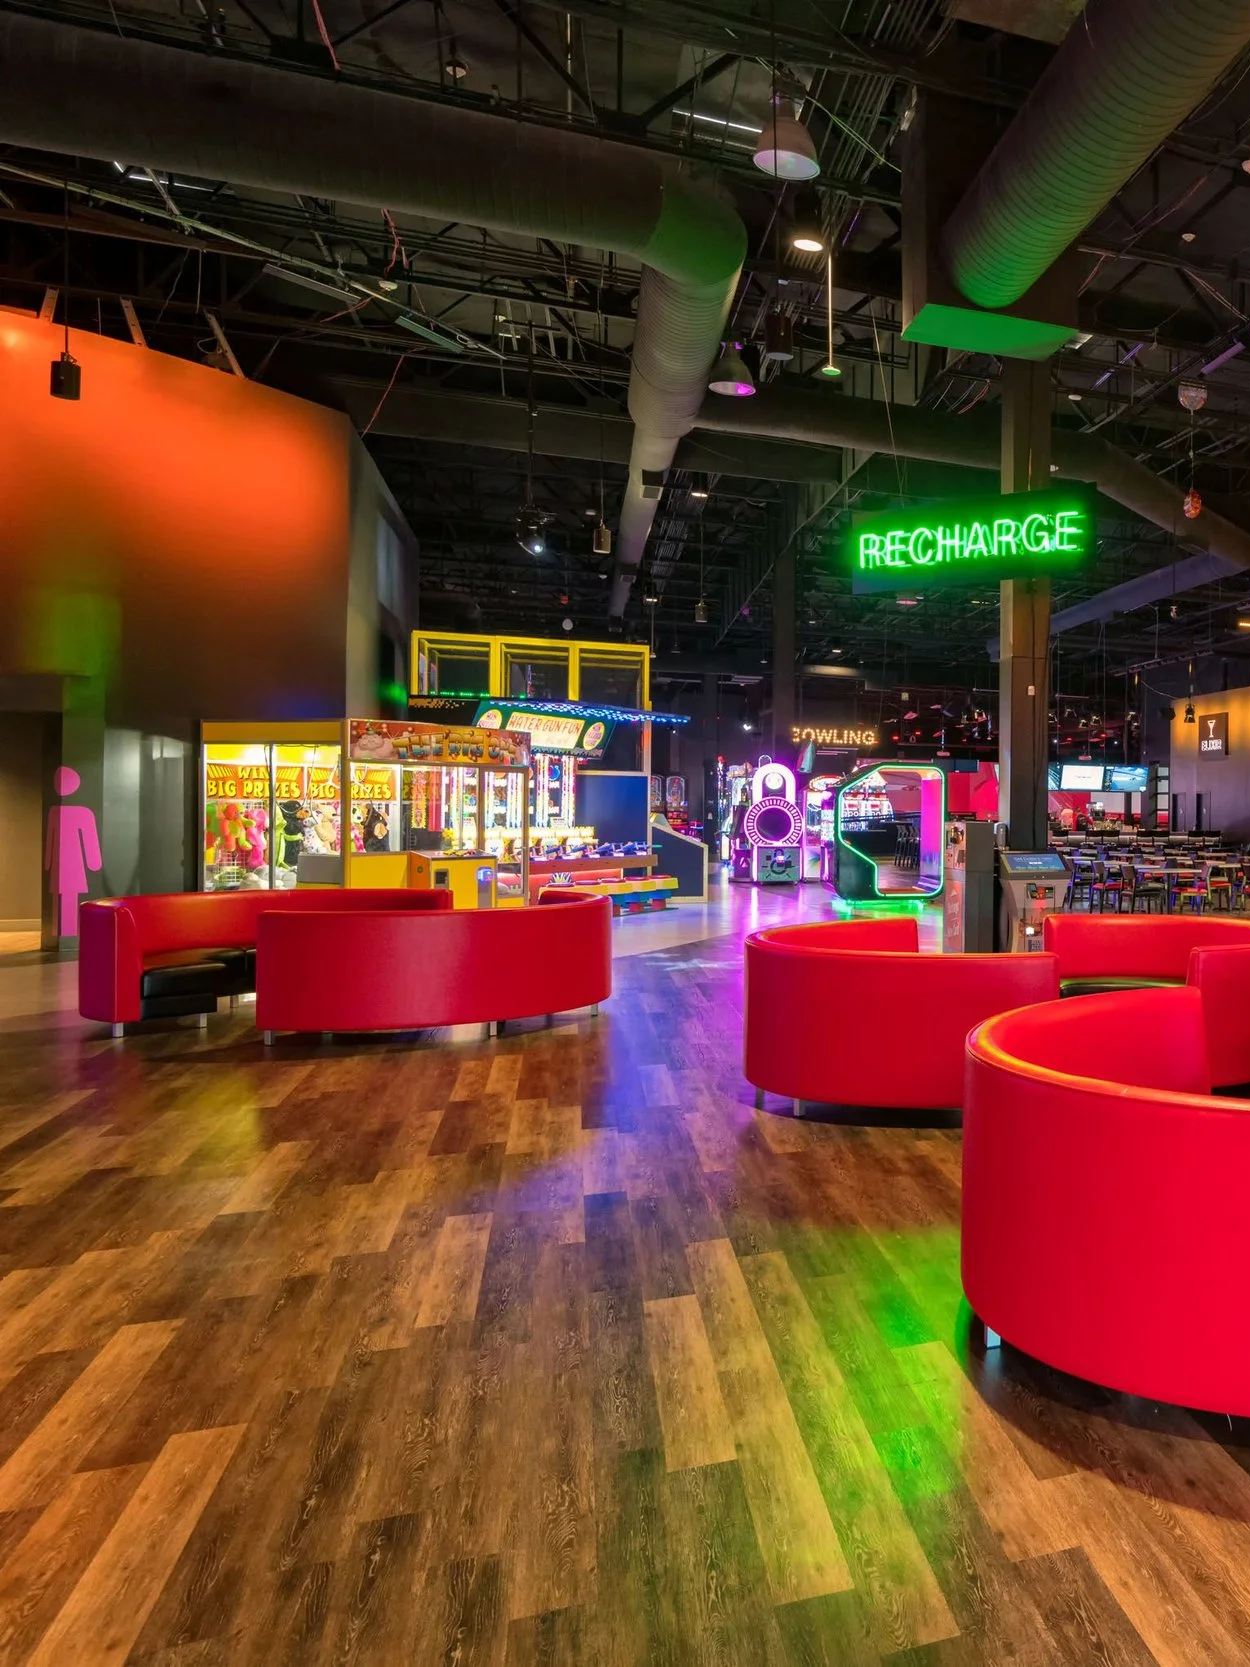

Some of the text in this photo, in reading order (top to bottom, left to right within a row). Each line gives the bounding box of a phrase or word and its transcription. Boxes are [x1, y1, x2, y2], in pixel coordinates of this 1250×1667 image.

[859, 511, 1081, 569] RECHARGE
[508, 714, 543, 731] WATER
[542, 719, 562, 733] GUN
[561, 720, 581, 735] FUN
[392, 733, 443, 759] THE
[447, 733, 484, 758] BIG
[237, 766, 270, 779] WIN
[207, 780, 236, 797] BIG
[310, 782, 392, 800] BIG RIZES
